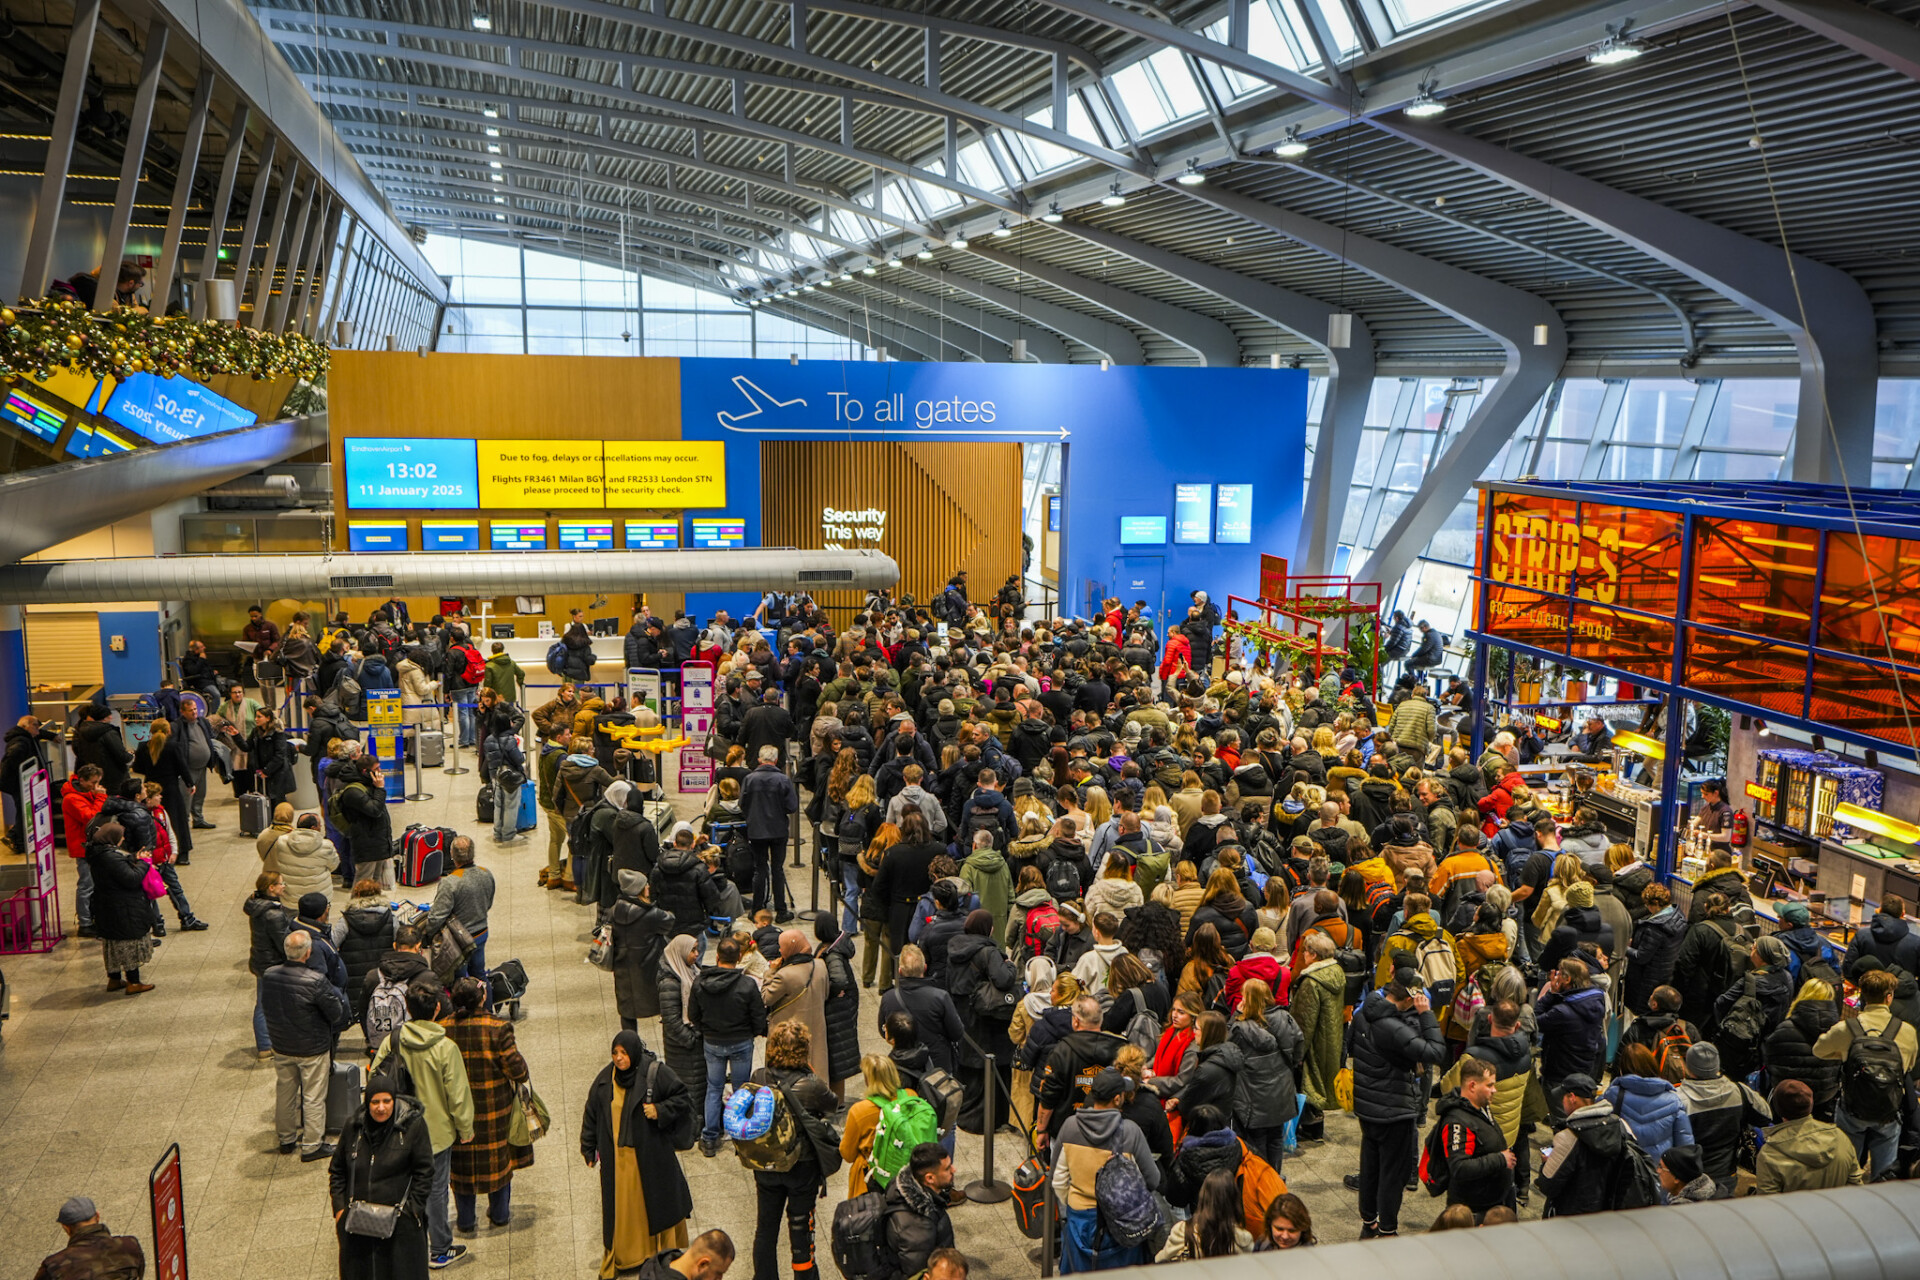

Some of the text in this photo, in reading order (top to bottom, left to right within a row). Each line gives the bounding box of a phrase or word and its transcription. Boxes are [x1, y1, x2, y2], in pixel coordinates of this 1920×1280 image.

[827, 392, 996, 429] To all gates
[500, 454, 519, 462] Due
[520, 454, 530, 462] to
[532, 454, 549, 463] fog,
[552, 454, 580, 463] delays
[594, 454, 652, 462] cancellations
[387, 463, 438, 478] 13:02
[492, 475, 522, 485] Flights
[524, 475, 557, 483] FR3461
[559, 475, 584, 483] Milan
[586, 475, 605, 483] BGY
[661, 475, 693, 483] London
[360, 485, 463, 498] 11 January 2025
[523, 486, 551, 495] please
[554, 486, 589, 495] proceed
[621, 486, 655, 495] security
[823, 507, 886, 525] Security
[822, 524, 884, 542] This way
[1492, 513, 1619, 604] STRIPES
[375, 1018, 392, 1032] 23
